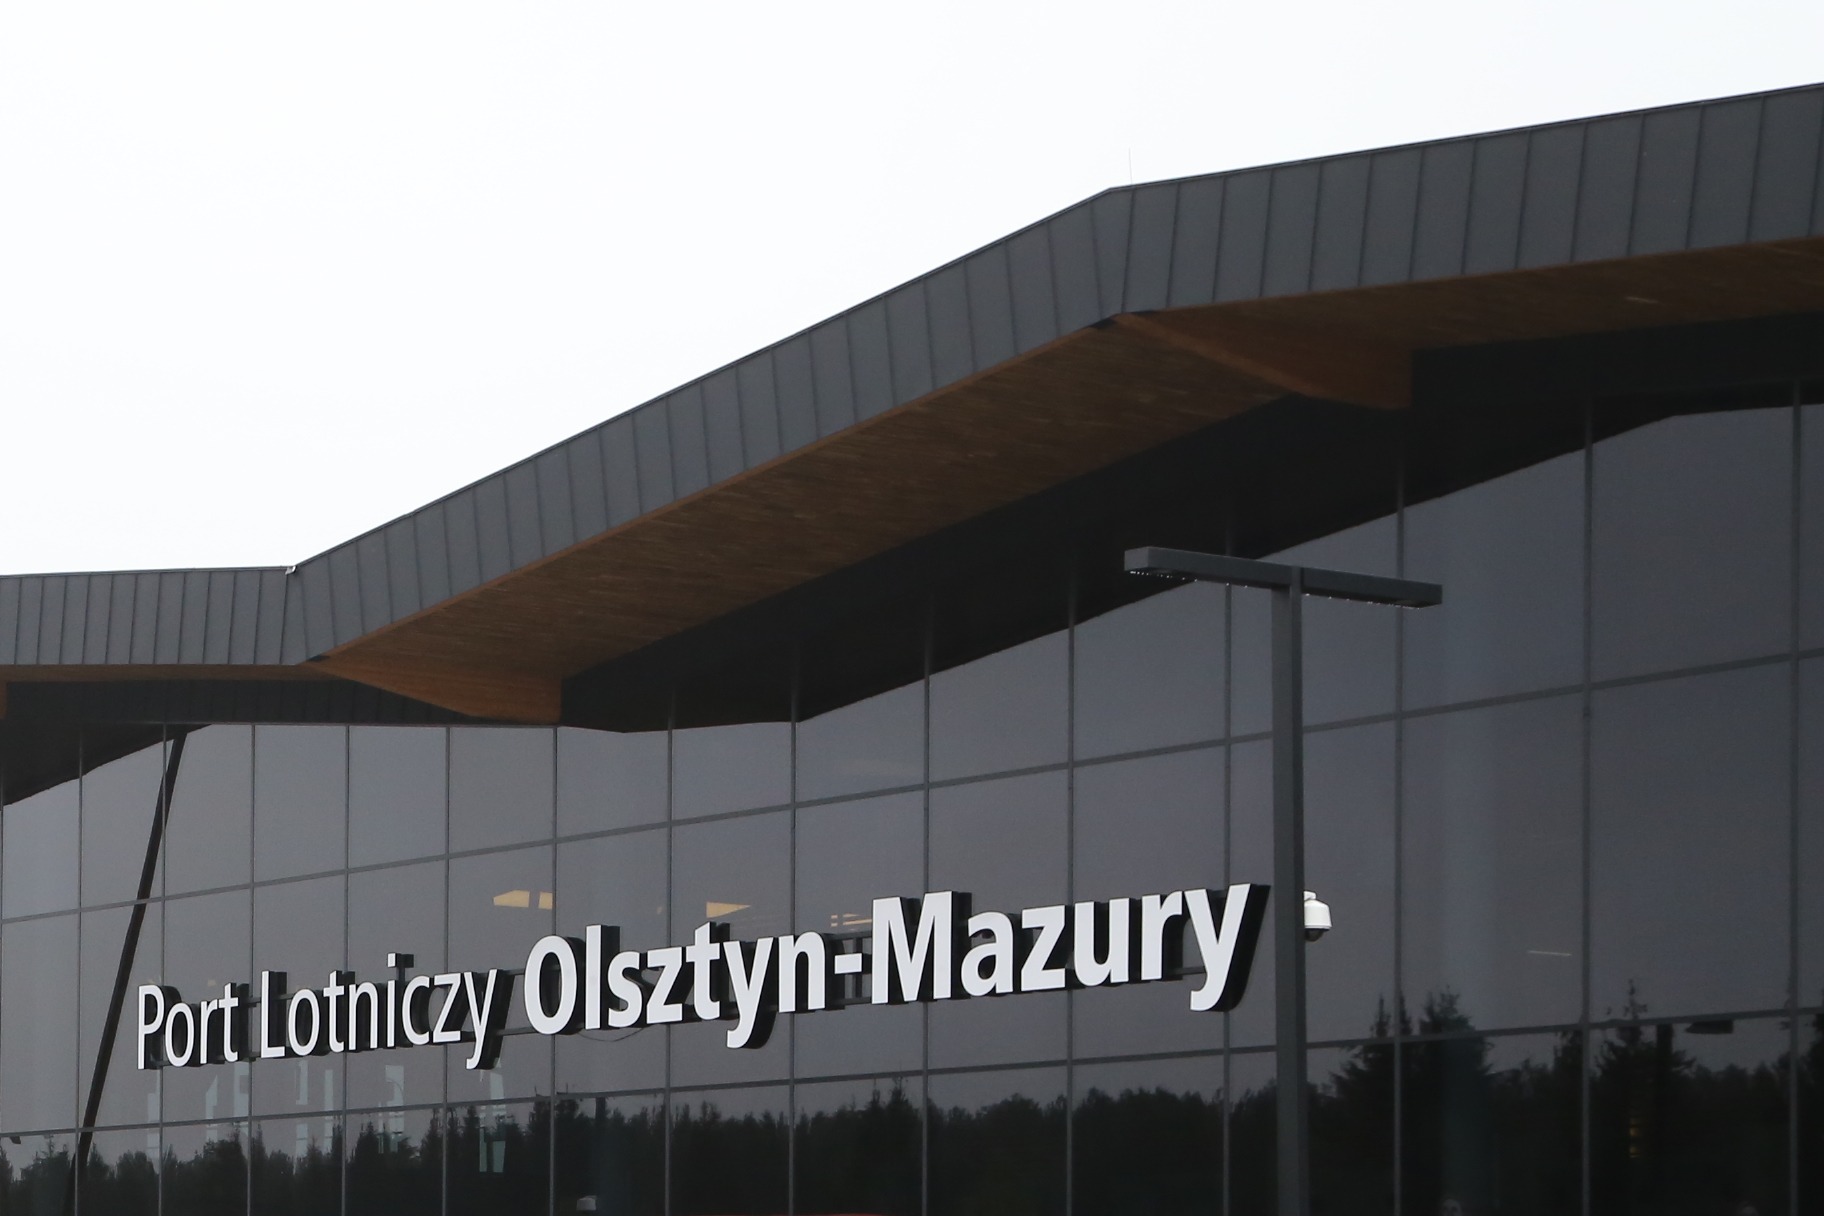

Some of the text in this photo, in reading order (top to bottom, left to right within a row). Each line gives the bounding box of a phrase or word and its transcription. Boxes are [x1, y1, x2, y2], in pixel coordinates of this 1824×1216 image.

[137, 883, 1252, 1070] Port Lotniczy Olsztyn-Mazury
